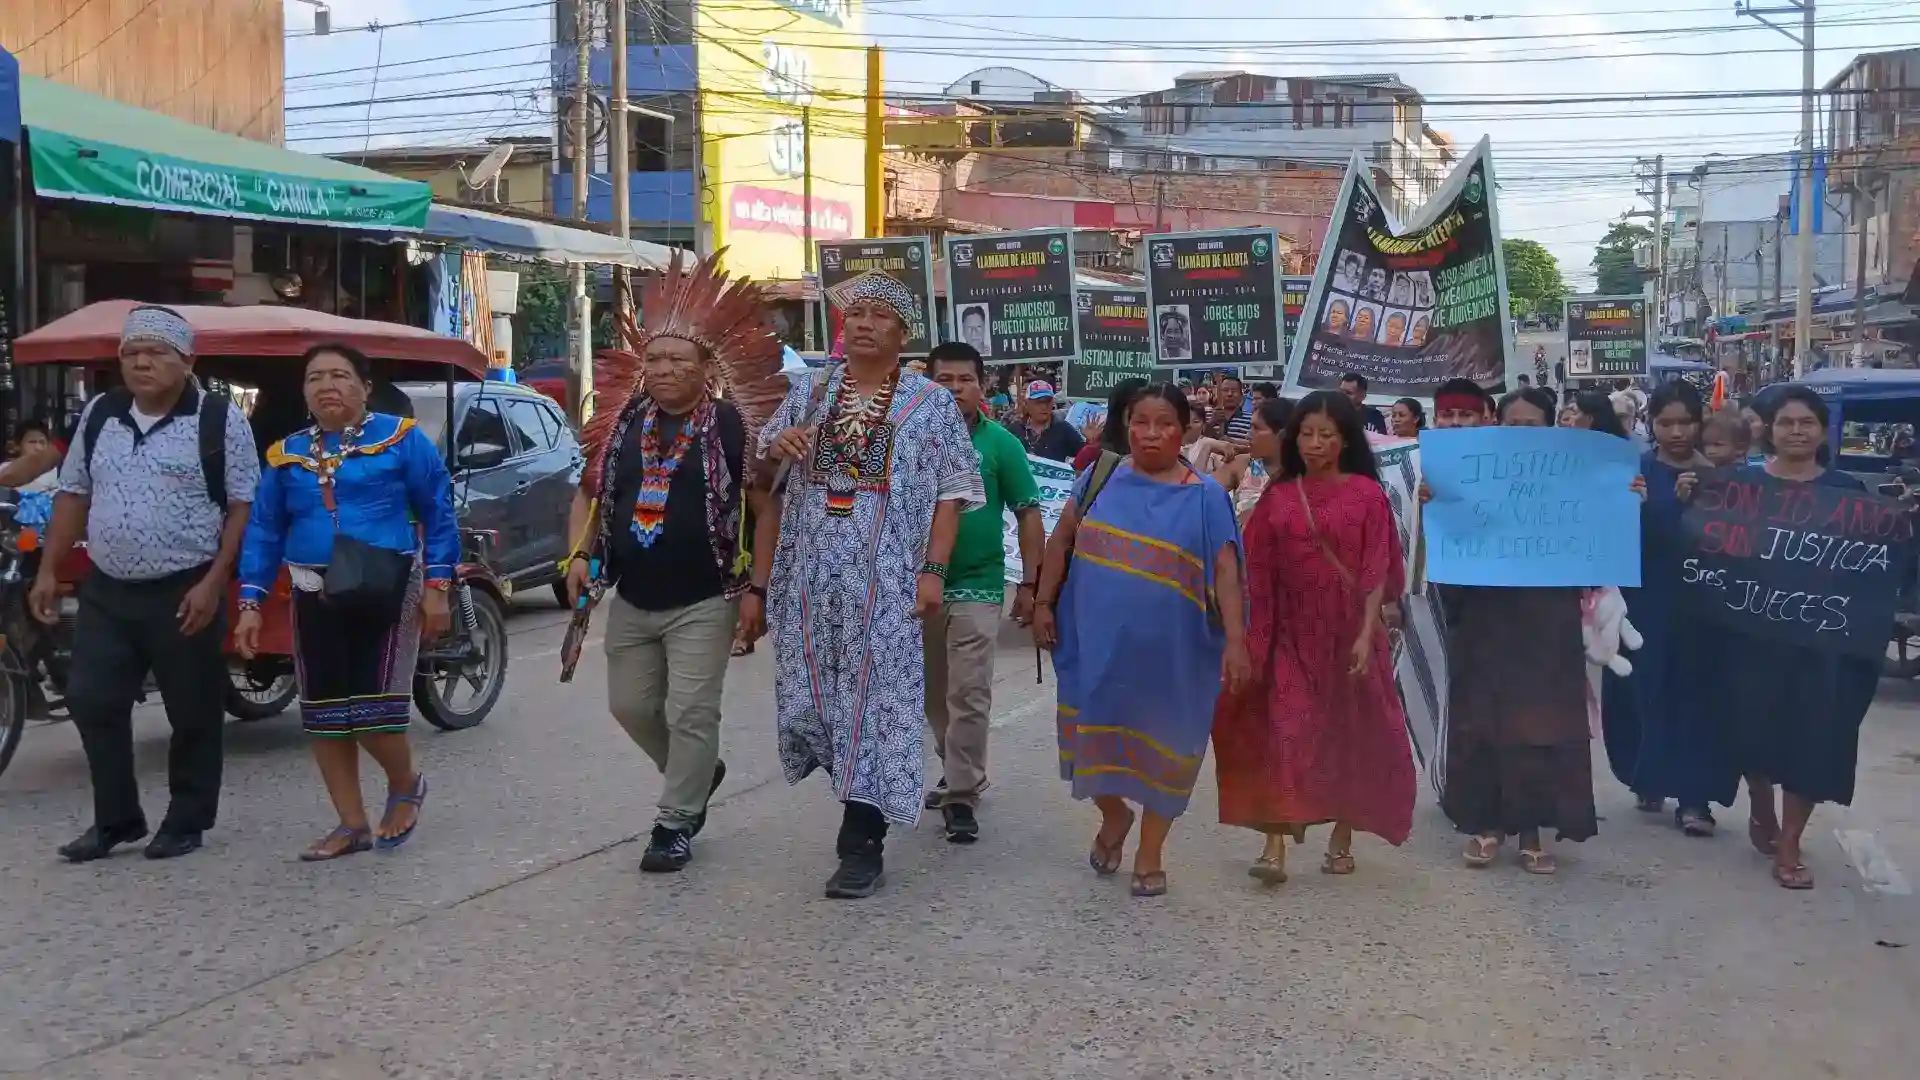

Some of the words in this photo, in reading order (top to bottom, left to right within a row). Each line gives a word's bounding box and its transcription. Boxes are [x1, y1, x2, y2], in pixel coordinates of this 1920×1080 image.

[136, 160, 245, 207] COMERCIAL
[1425, 210, 1465, 249] ALERTA
[844, 257, 873, 272] LLAMADO
[883, 256, 906, 270] ALERTA
[976, 253, 1009, 269] LLAMADO
[1010, 253, 1019, 267] DE
[1020, 251, 1046, 266] ALERTA
[1178, 254, 1210, 270] LLAMADO
[1212, 253, 1221, 268] DE
[1223, 251, 1248, 267] ALERTA
[1436, 266, 1458, 290] CASO
[1488, 252, 1494, 270] Y
[1003, 301, 1056, 319] FRANCISCO
[1094, 304, 1123, 318] LLAMADO
[1124, 306, 1132, 318] DE
[1204, 305, 1233, 321] JORGE
[1433, 309, 1446, 328] DE
[1448, 296, 1496, 326] AUDIENCIAS
[992, 319, 1026, 336] PINEDO
[1028, 316, 1069, 334] RAMIREZ
[1219, 321, 1248, 338] PEREZ
[1003, 335, 1063, 352] PRESENTE
[1203, 339, 1267, 356] PRESENTE
[1323, 343, 1344, 356] Fecha:
[1372, 354, 1381, 362] 02
[1433, 353, 1449, 362] 2023
[1074, 348, 1114, 367] JUSTICIA
[1115, 349, 1134, 368] QUE
[1339, 360, 1353, 369] 5:30
[1599, 361, 1640, 371] PRESENTE
[1085, 370, 1104, 391] ¿ES
[1316, 365, 1338, 377] Lugar:
[1377, 375, 1387, 383] del
[1408, 376, 1430, 384] Judicial
[1701, 479, 1764, 518] SON
[1698, 520, 1752, 558] SIN
[1760, 526, 1892, 573] JUSTICIA
[1682, 558, 1728, 590] Sres.
[1725, 580, 1850, 637] JUECES.
